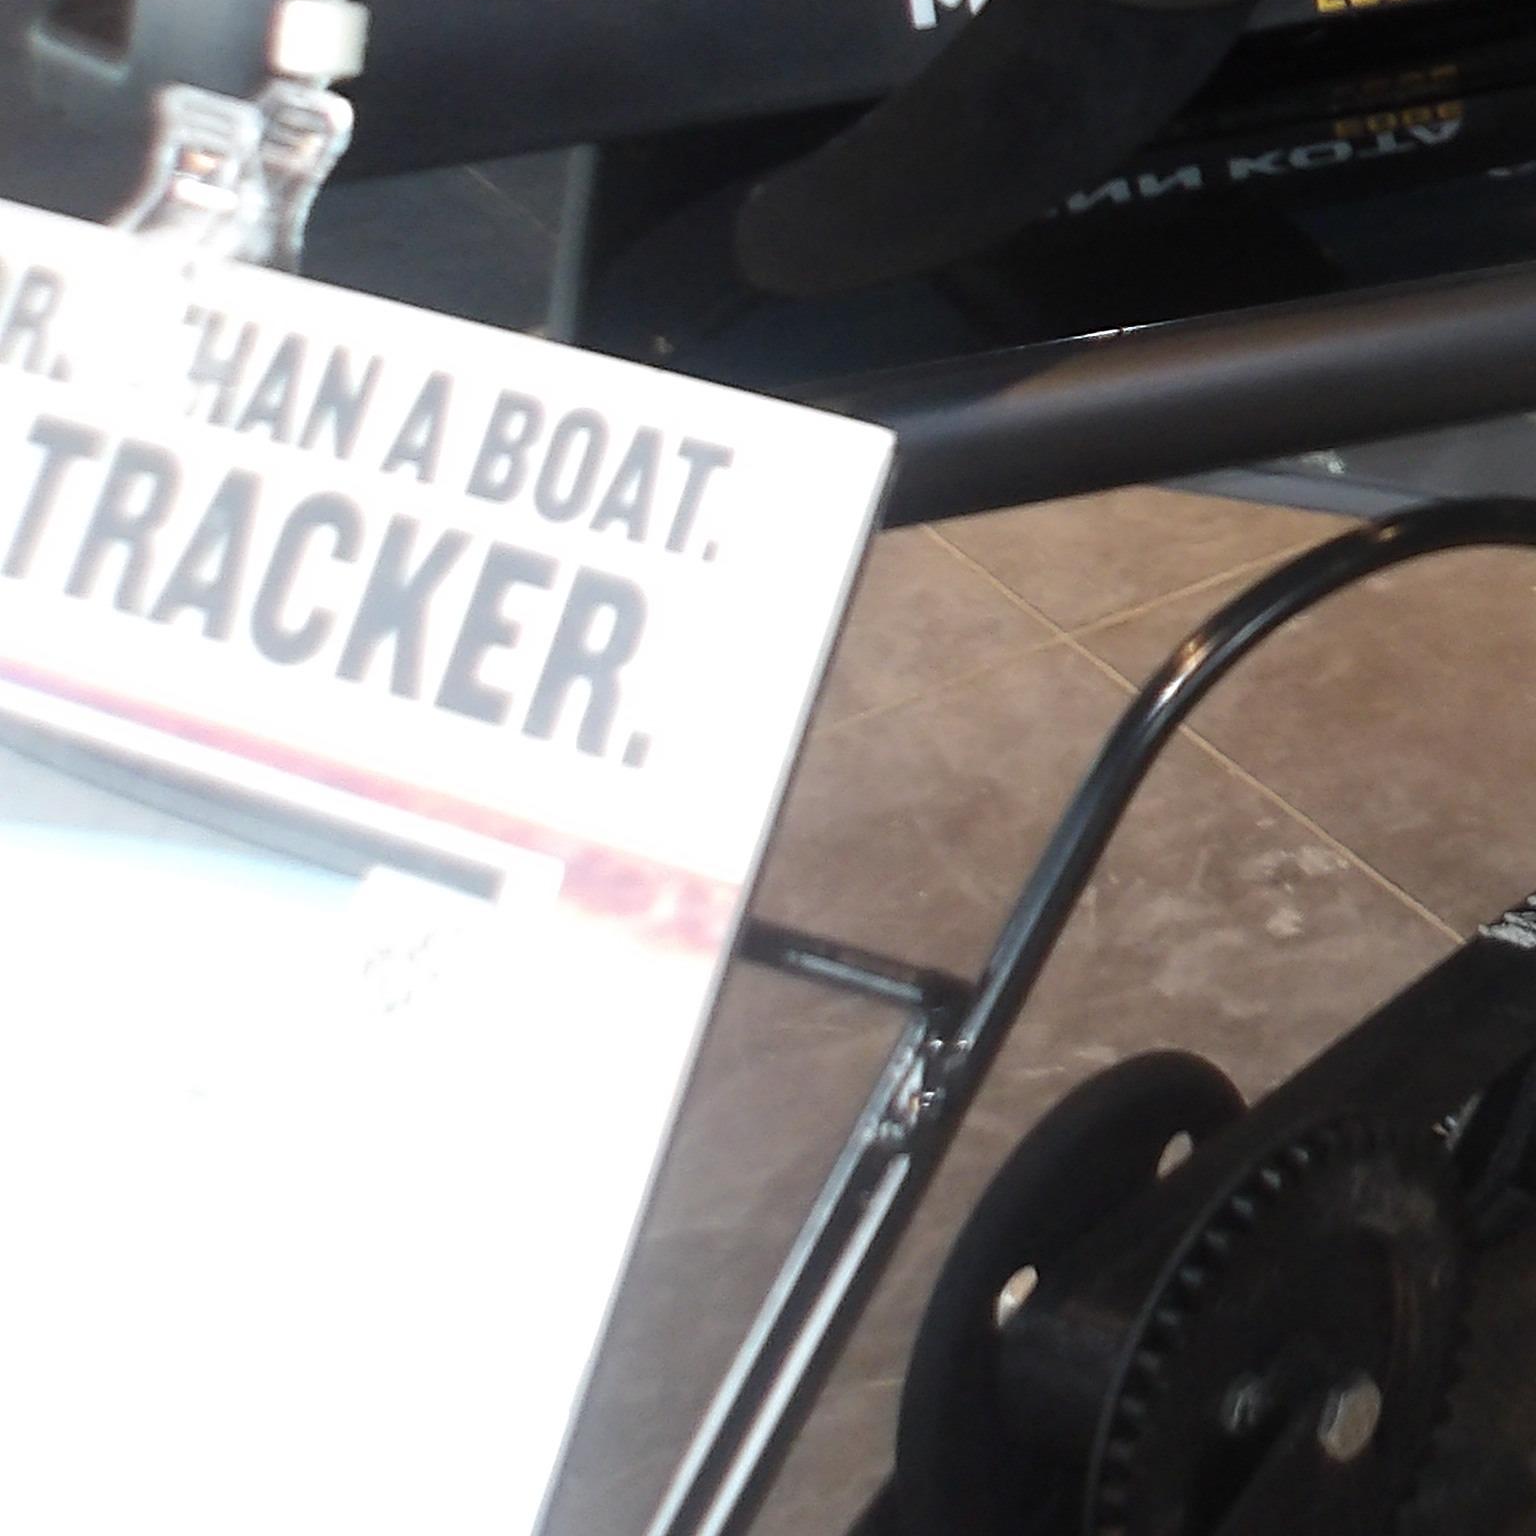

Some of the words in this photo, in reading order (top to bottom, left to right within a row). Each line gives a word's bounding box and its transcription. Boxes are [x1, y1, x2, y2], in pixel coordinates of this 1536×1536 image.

[183, 304, 383, 461] HAN
[380, 369, 454, 484] A
[464, 387, 735, 563] BOAT.
[2, 413, 655, 770] TRACKER.
